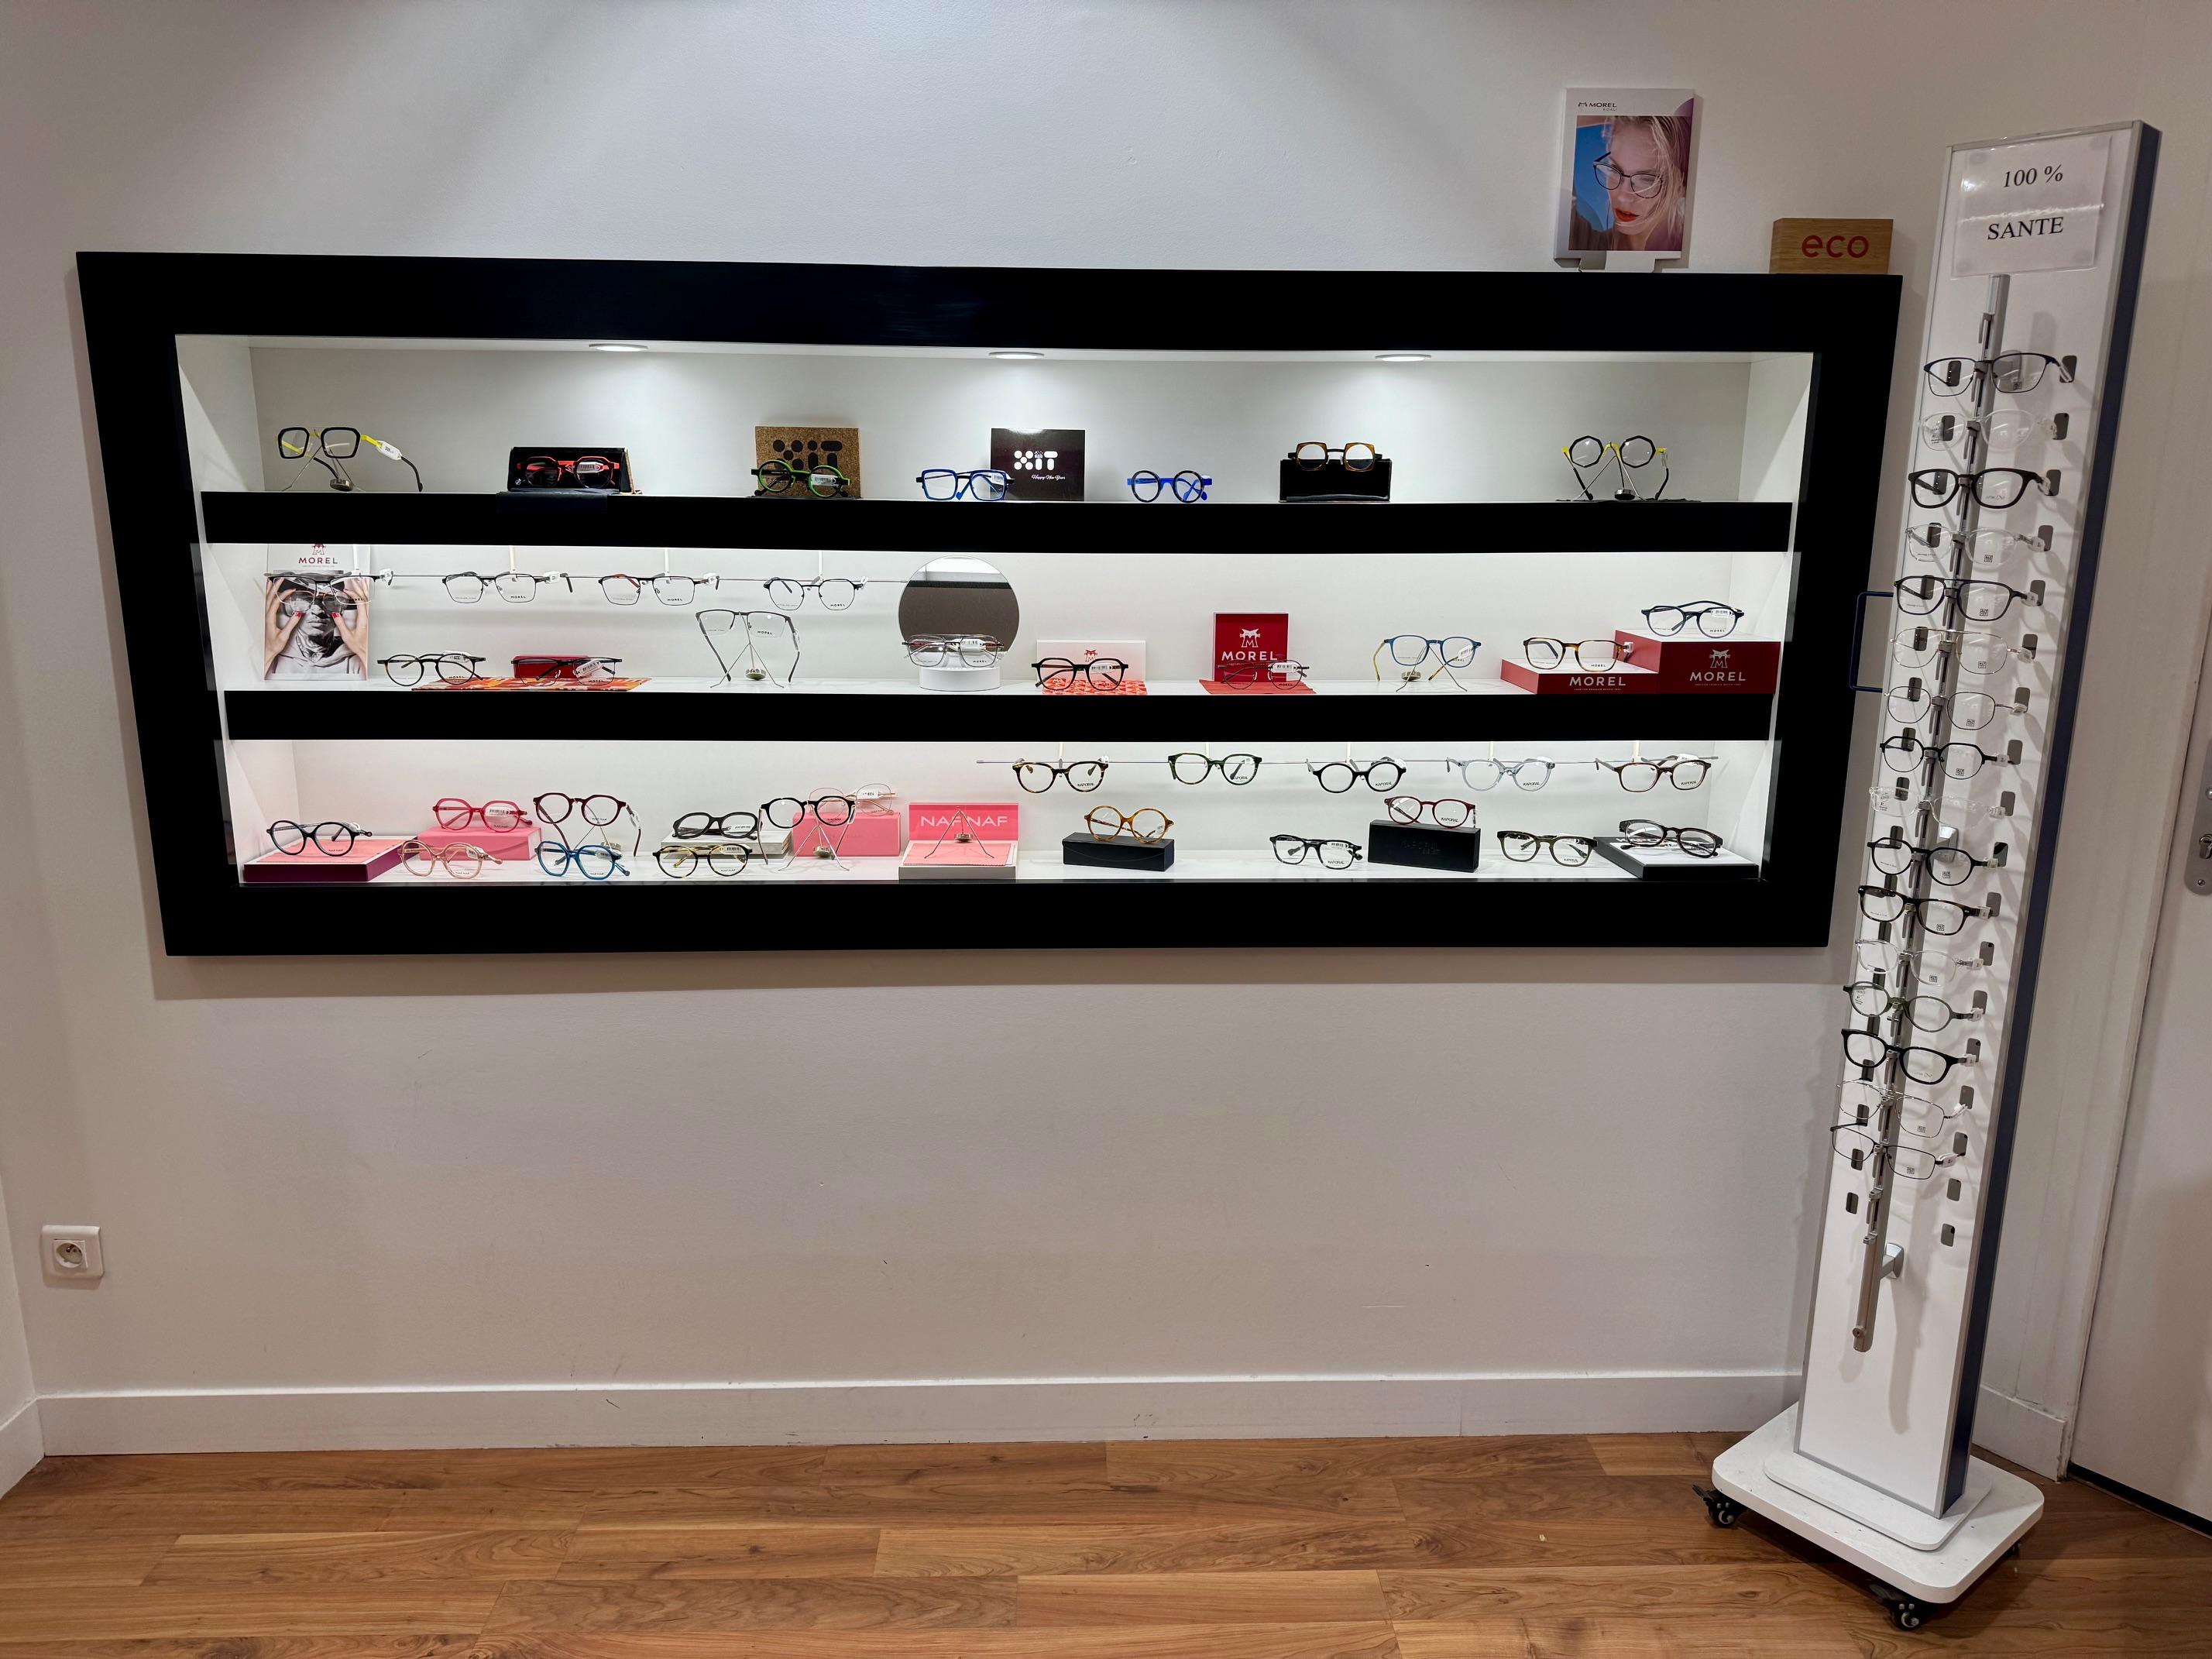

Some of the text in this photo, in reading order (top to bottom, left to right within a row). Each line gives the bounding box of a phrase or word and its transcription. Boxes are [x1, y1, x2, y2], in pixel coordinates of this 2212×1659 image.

[2004, 164, 2063, 187] 100 %
[1987, 217, 2064, 240] SANTE
[1801, 235, 1869, 259] eco
[1221, 651, 1277, 661] MOREL
[1569, 676, 1626, 686] MOREL
[1689, 672, 1747, 682] MOREL
[920, 816, 1008, 826] NAF NAF
